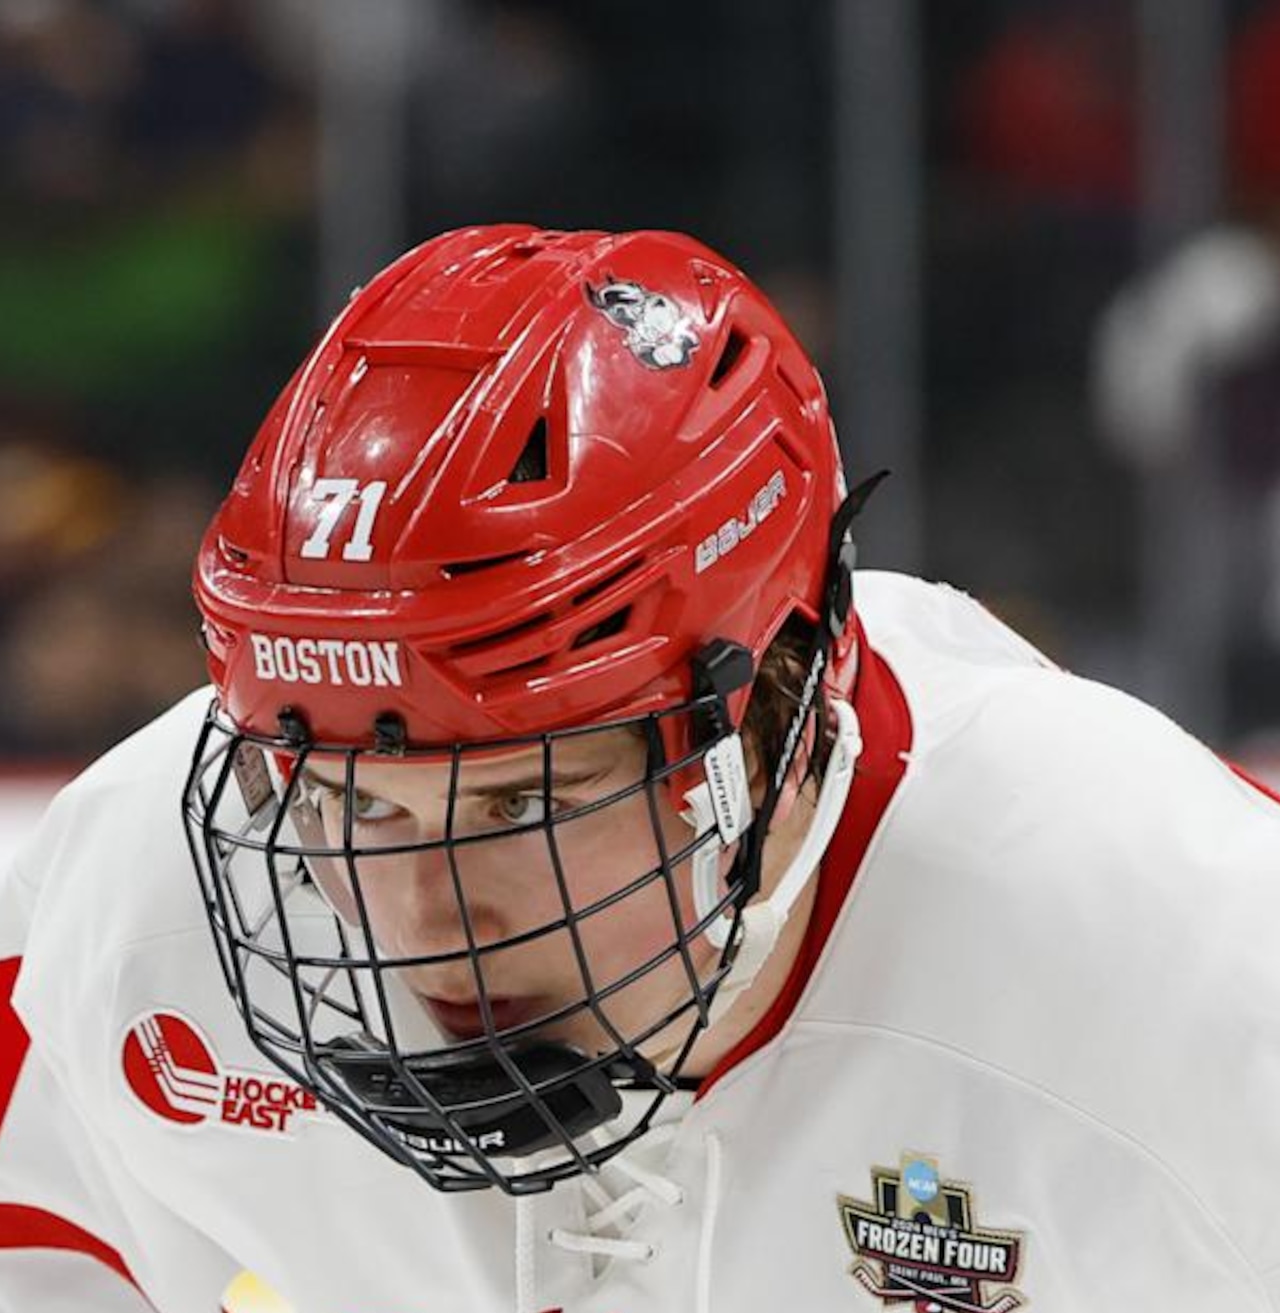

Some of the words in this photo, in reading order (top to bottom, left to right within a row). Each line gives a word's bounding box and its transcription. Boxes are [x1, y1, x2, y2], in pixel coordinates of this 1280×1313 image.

[300, 478, 387, 561] 71
[250, 633, 402, 687] BOSTON
[221, 1099, 294, 1132] EAST
[224, 1075, 317, 1111] HOCKE
[856, 1220, 941, 1264] FROZEN
[943, 1239, 1007, 1273] FOUR
